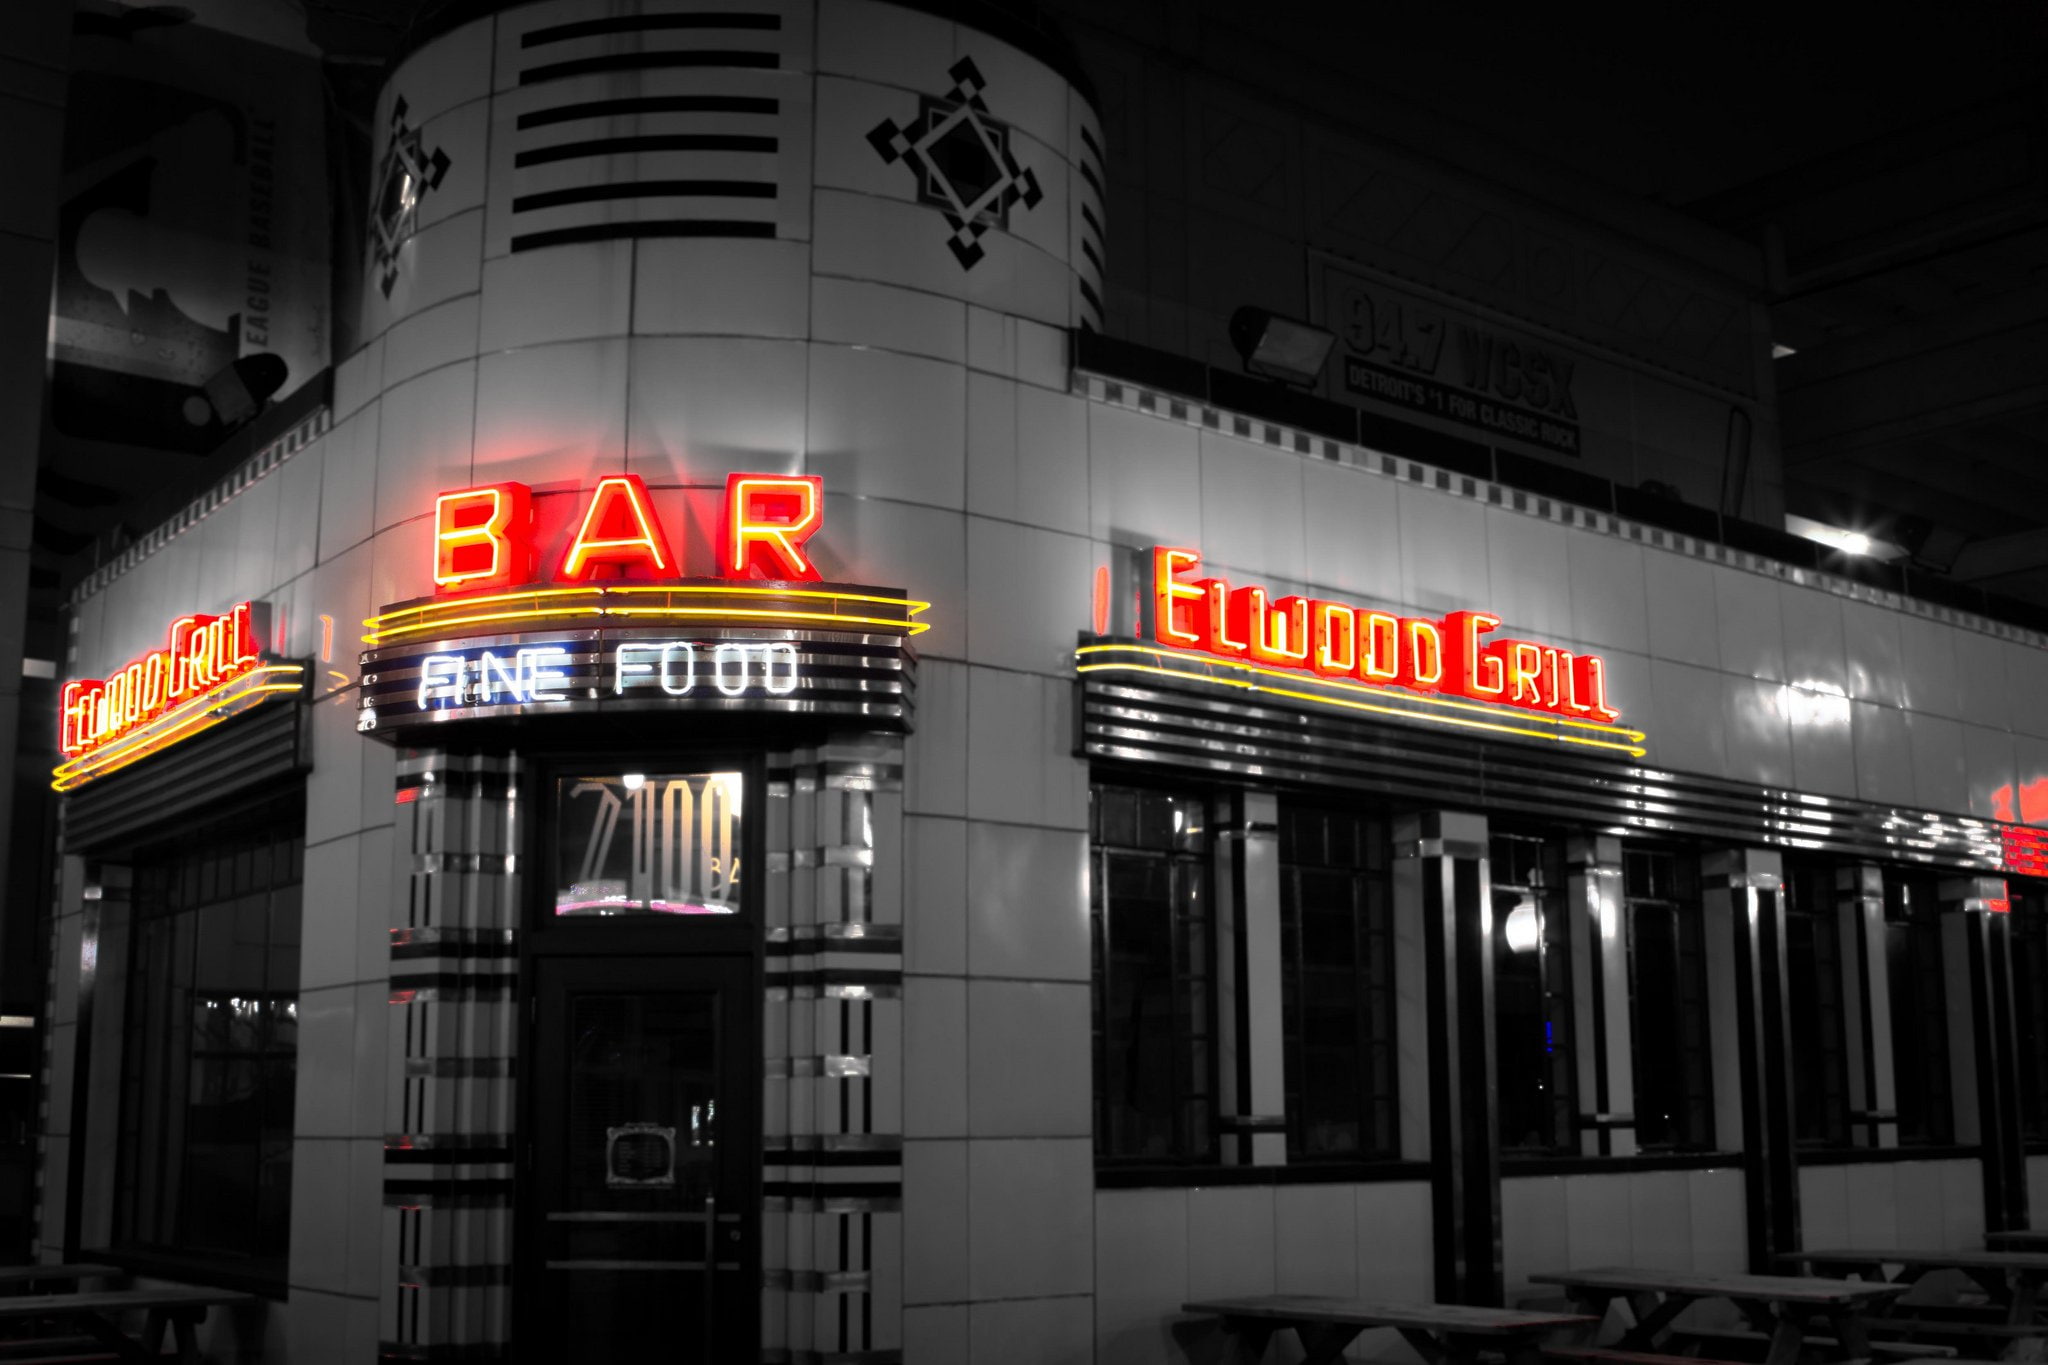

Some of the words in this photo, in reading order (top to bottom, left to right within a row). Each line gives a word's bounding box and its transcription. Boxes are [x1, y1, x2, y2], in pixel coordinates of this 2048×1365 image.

[249, 118, 275, 249] BASEBALL
[246, 260, 272, 348] EAGUE
[1343, 289, 1446, 375] 94.7
[1453, 321, 1578, 420] WCSX
[1350, 363, 1425, 405] DETROIT'S
[1450, 396, 1477, 421] FOR
[1480, 403, 1540, 439] CLASSIC
[1540, 418, 1578, 450] ROCK
[434, 473, 823, 590] BAR
[417, 645, 567, 710] FINE
[615, 641, 799, 697] FOOD
[1158, 546, 1443, 688] ELWOOD
[1458, 611, 1620, 722] GRILL
